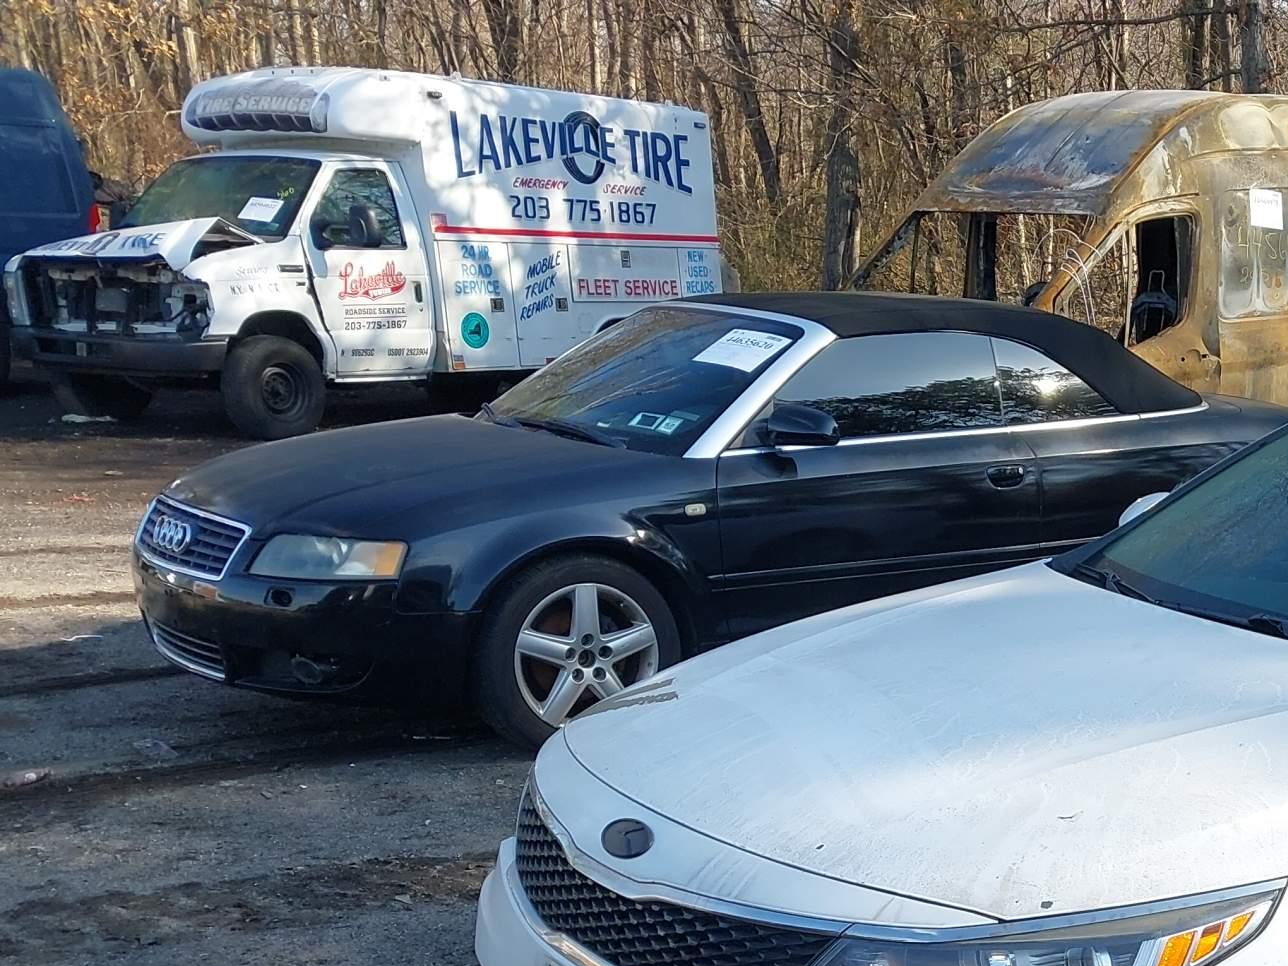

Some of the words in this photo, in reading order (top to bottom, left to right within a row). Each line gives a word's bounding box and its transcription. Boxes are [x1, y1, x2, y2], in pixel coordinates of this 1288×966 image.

[195, 98, 232, 115] TIRE
[234, 95, 311, 114] SERVICE
[450, 110, 616, 178] LAKEVILLE
[623, 129, 692, 194] TIRE
[513, 177, 568, 189] EMERGENCY
[603, 184, 647, 195] SERVICE
[510, 195, 550, 219] 203
[461, 245, 476, 259] 24
[461, 264, 493, 278] ROAD
[527, 250, 561, 280] MOBILE
[455, 281, 500, 296] SERVICE
[525, 272, 557, 299] TRUCK
[577, 279, 619, 296] FLEET
[625, 280, 679, 296] SERVICE
[686, 281, 715, 293] RECAPS
[345, 307, 377, 316] ROADSIDE
[520, 294, 555, 321] REPAIRS
[344, 320, 407, 331] 203-775-1867
